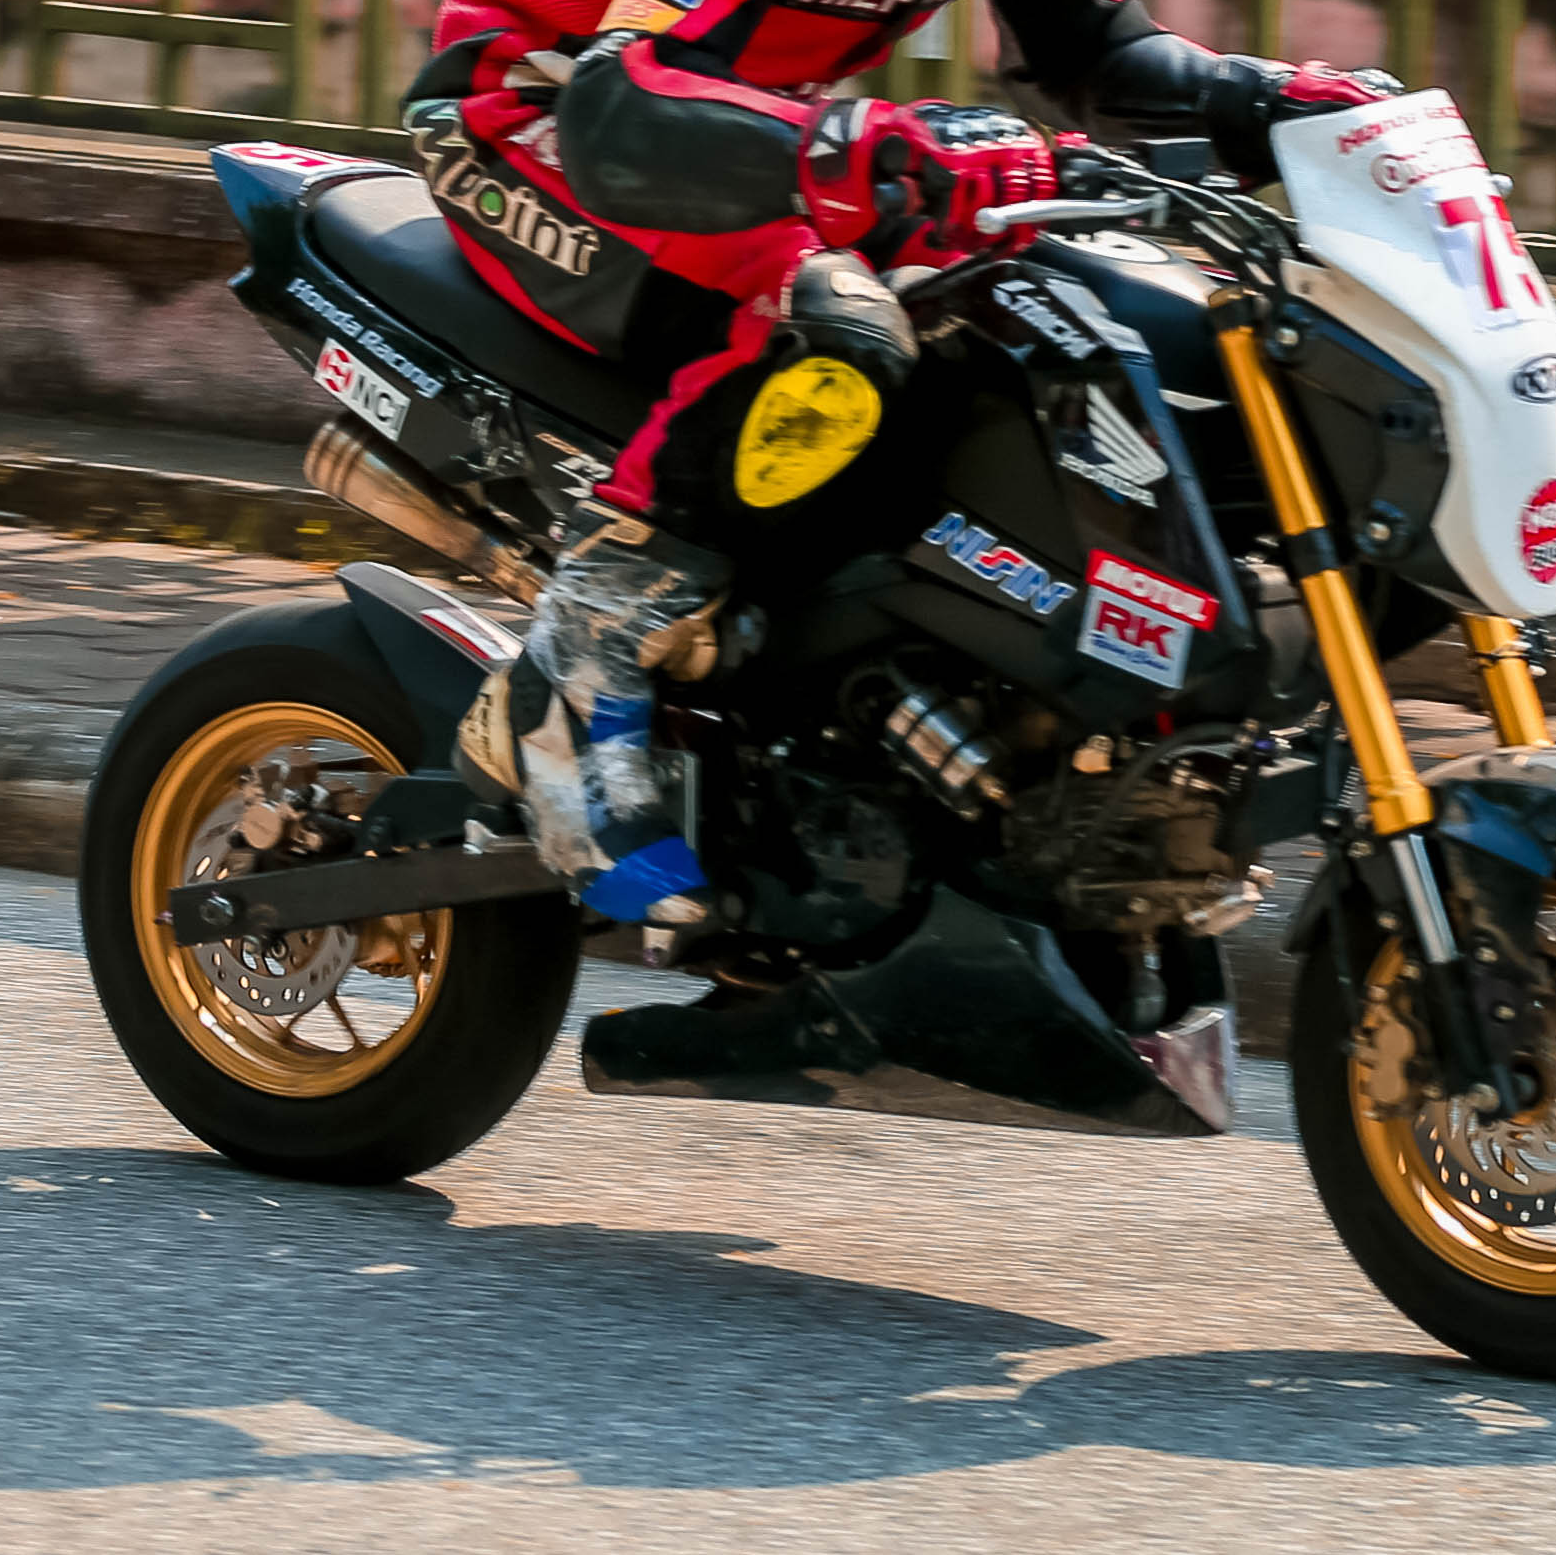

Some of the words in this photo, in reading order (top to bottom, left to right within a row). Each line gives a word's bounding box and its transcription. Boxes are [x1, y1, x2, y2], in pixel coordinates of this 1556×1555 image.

[286, 277, 364, 338] Honda
[356, 328, 444, 399] Racing
[1092, 558, 1209, 622] MOTUL
[1095, 599, 1177, 659] RK
